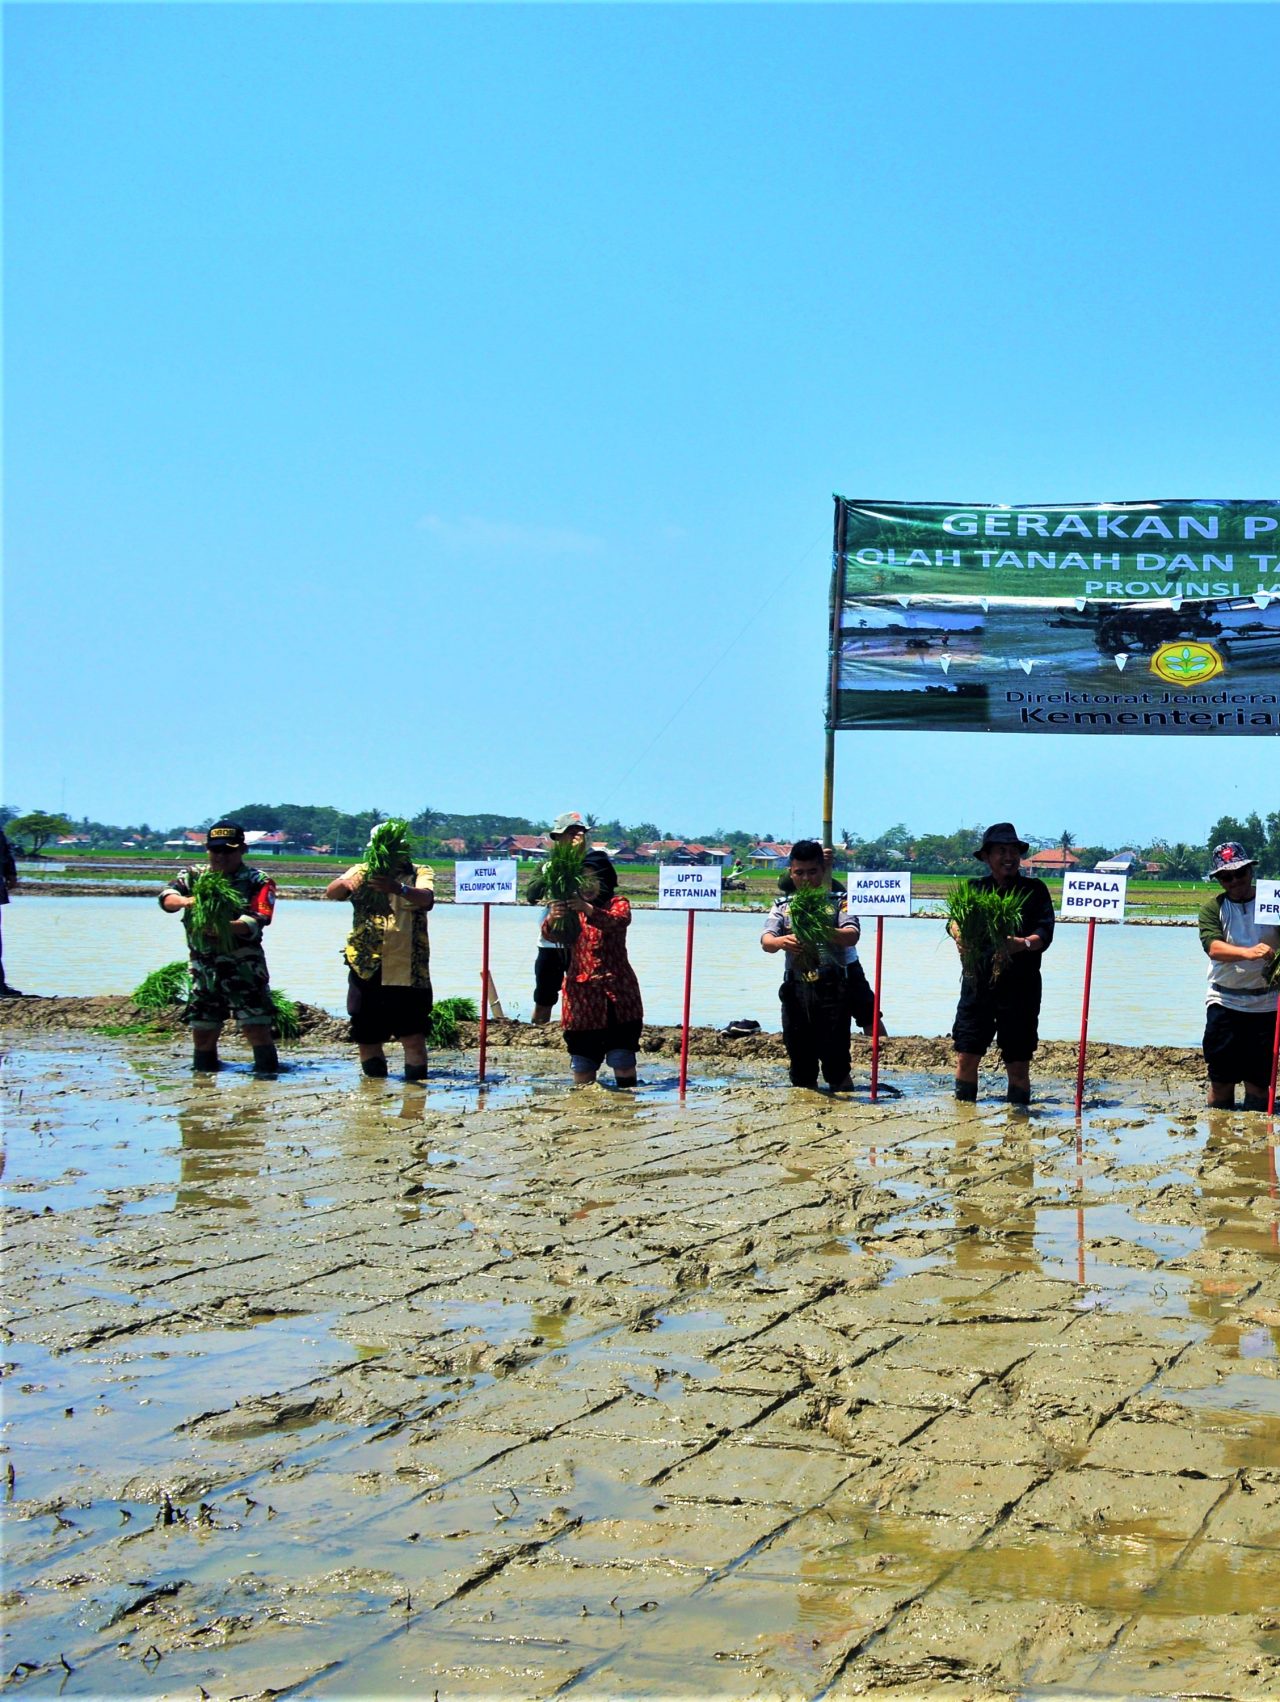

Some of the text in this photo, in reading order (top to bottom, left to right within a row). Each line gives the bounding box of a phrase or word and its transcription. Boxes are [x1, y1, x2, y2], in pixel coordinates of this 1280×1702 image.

[942, 513, 1219, 539] GERAKAN
[856, 547, 961, 567] OLAH
[973, 551, 1119, 570] TANAH
[1136, 553, 1235, 572] DAN
[1085, 581, 1240, 596] PROVINSI
[1005, 691, 1152, 704] Direktorat
[474, 868, 497, 877] KETUA
[677, 874, 702, 883] UPTD
[459, 882, 513, 892] KELOMPOK TANI
[856, 880, 901, 889] KAPOLSEK
[1068, 880, 1120, 893] KEPALA
[663, 888, 717, 898] PERTANIAN
[851, 894, 906, 904] PUSAKAJAYA
[1066, 897, 1120, 909] BBPOPT
